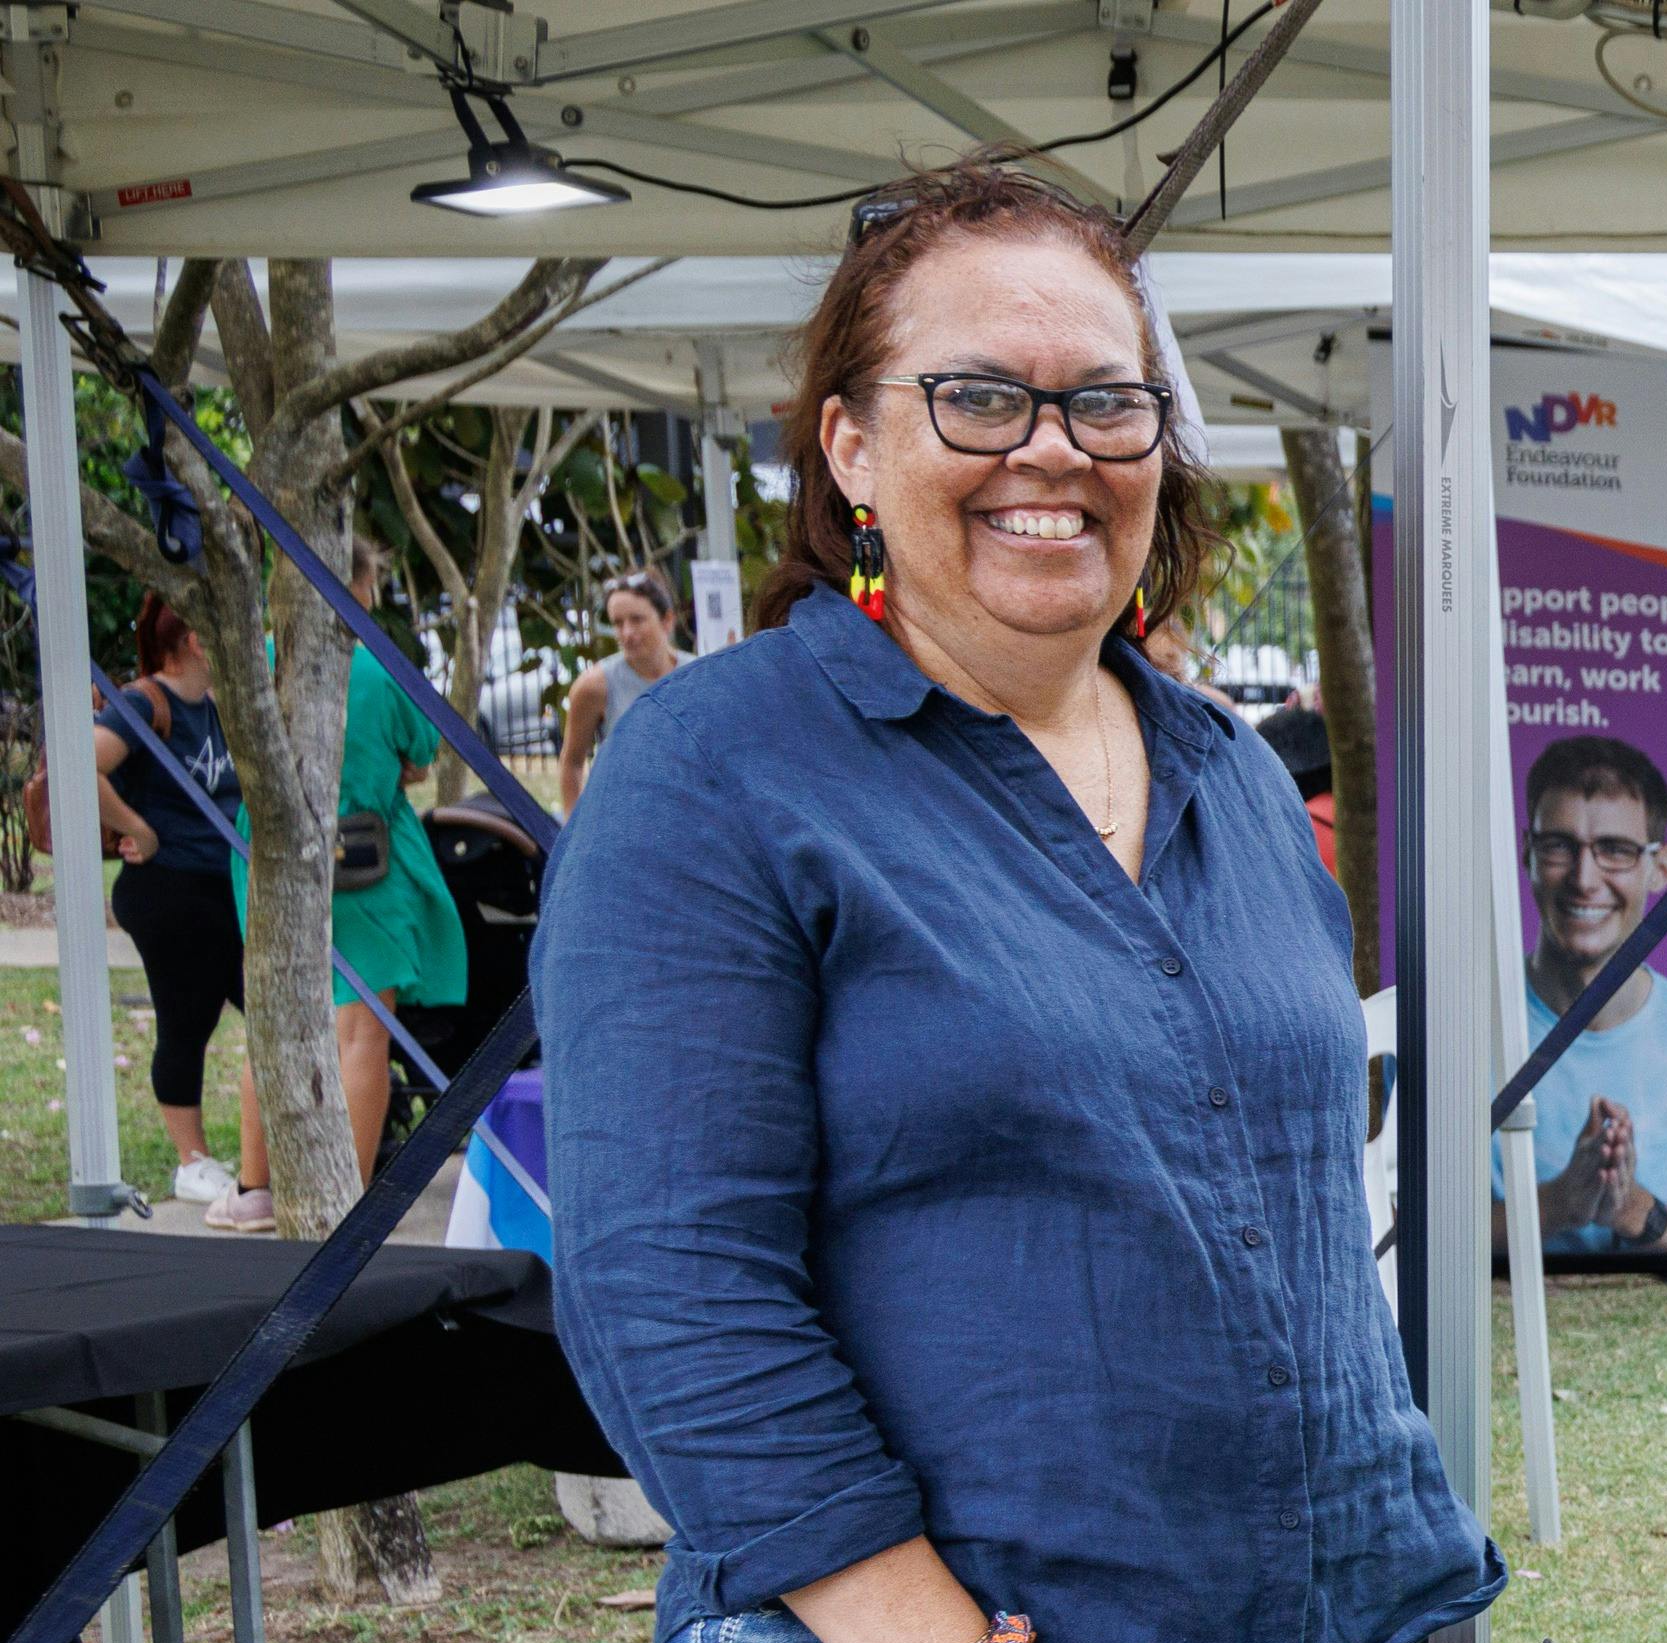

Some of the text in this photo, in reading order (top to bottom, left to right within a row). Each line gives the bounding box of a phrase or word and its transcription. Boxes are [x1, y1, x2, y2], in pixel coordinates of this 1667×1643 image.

[1505, 444, 1621, 469] Endeavour
[1506, 465, 1622, 492] Foundation
[1441, 477, 1453, 613] EXTREME MARQUEES
[1502, 586, 1592, 616] pport
[1504, 664, 1662, 693] arn, work
[1507, 697, 1610, 728] ourish.
